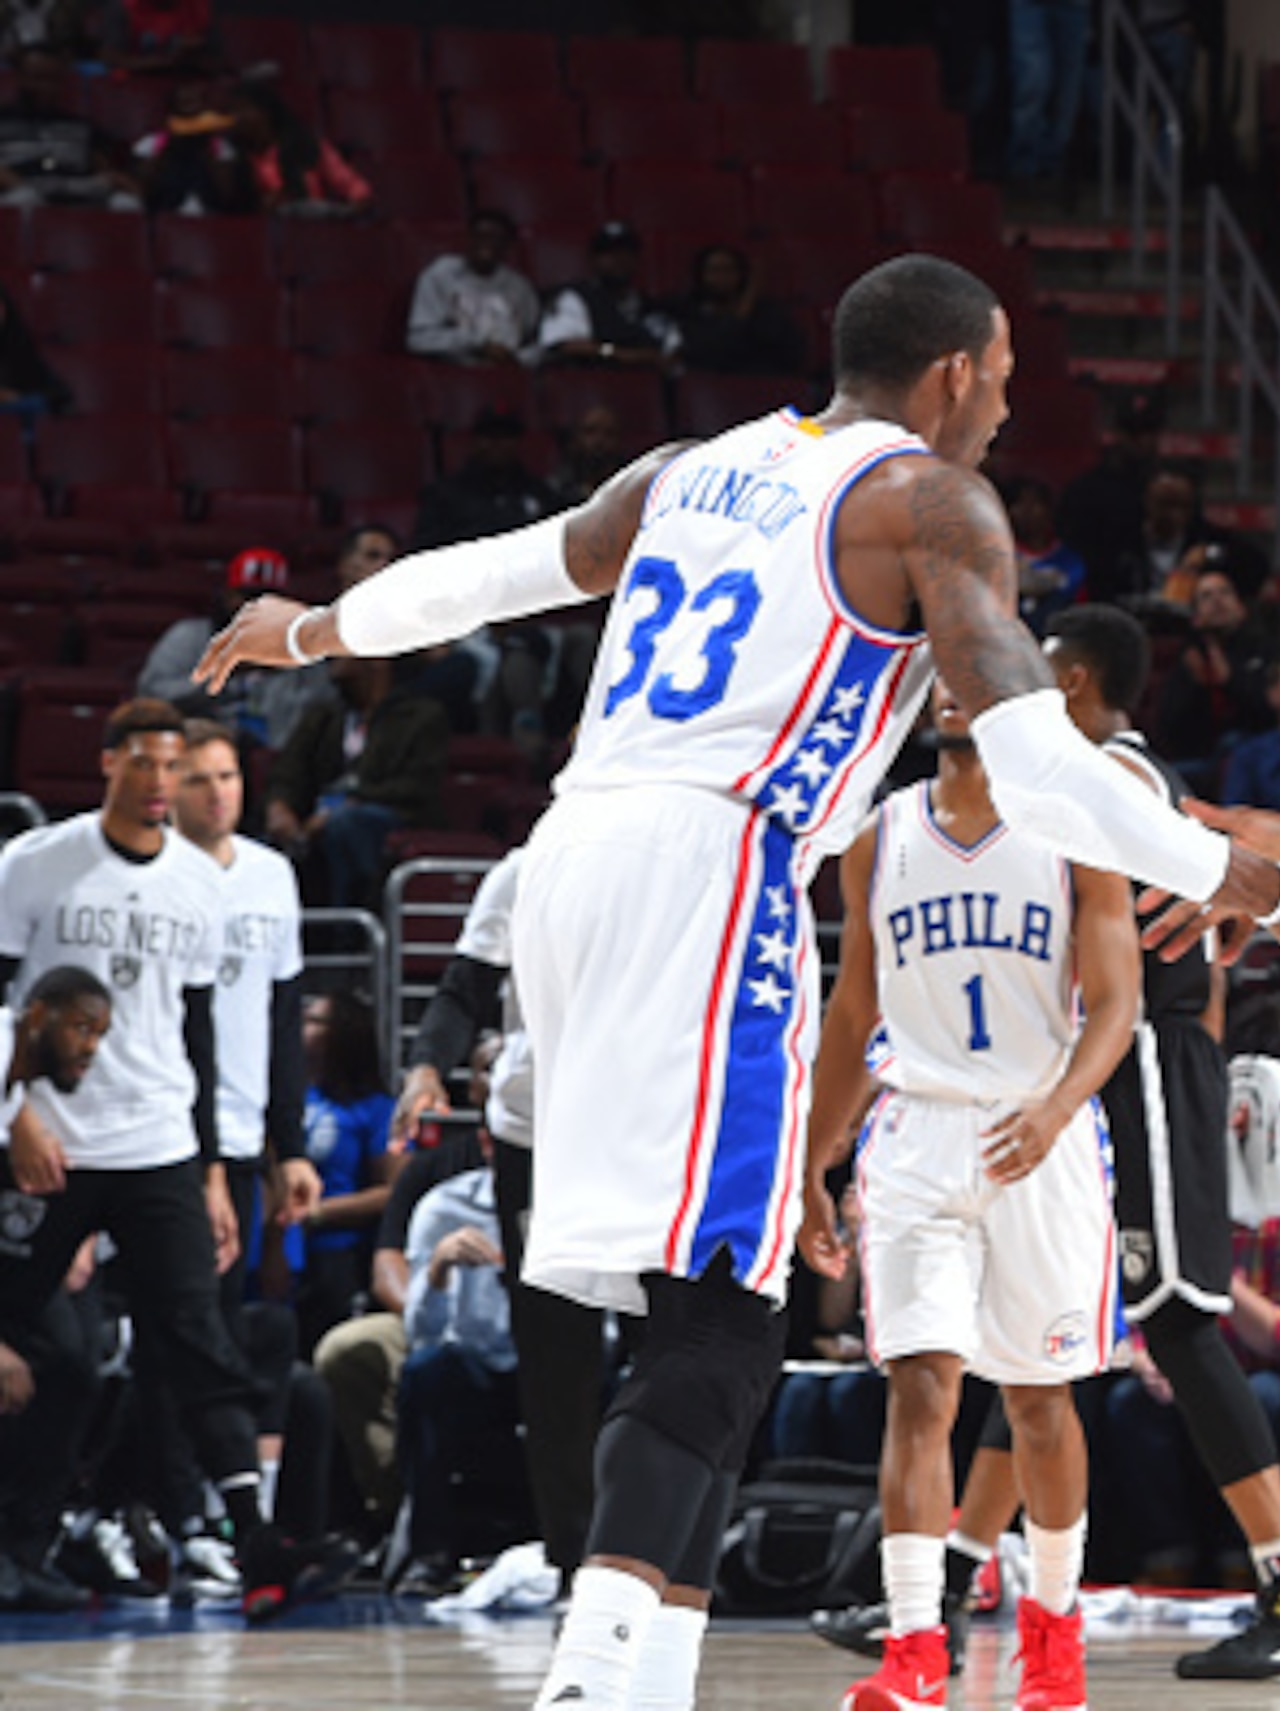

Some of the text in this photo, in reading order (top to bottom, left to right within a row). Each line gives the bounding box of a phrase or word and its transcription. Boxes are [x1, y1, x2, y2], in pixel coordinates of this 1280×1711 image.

[603, 556, 763, 724] 33
[56, 904, 113, 948] LOS
[887, 892, 1053, 969] PHILA
[963, 973, 992, 1052] 1
